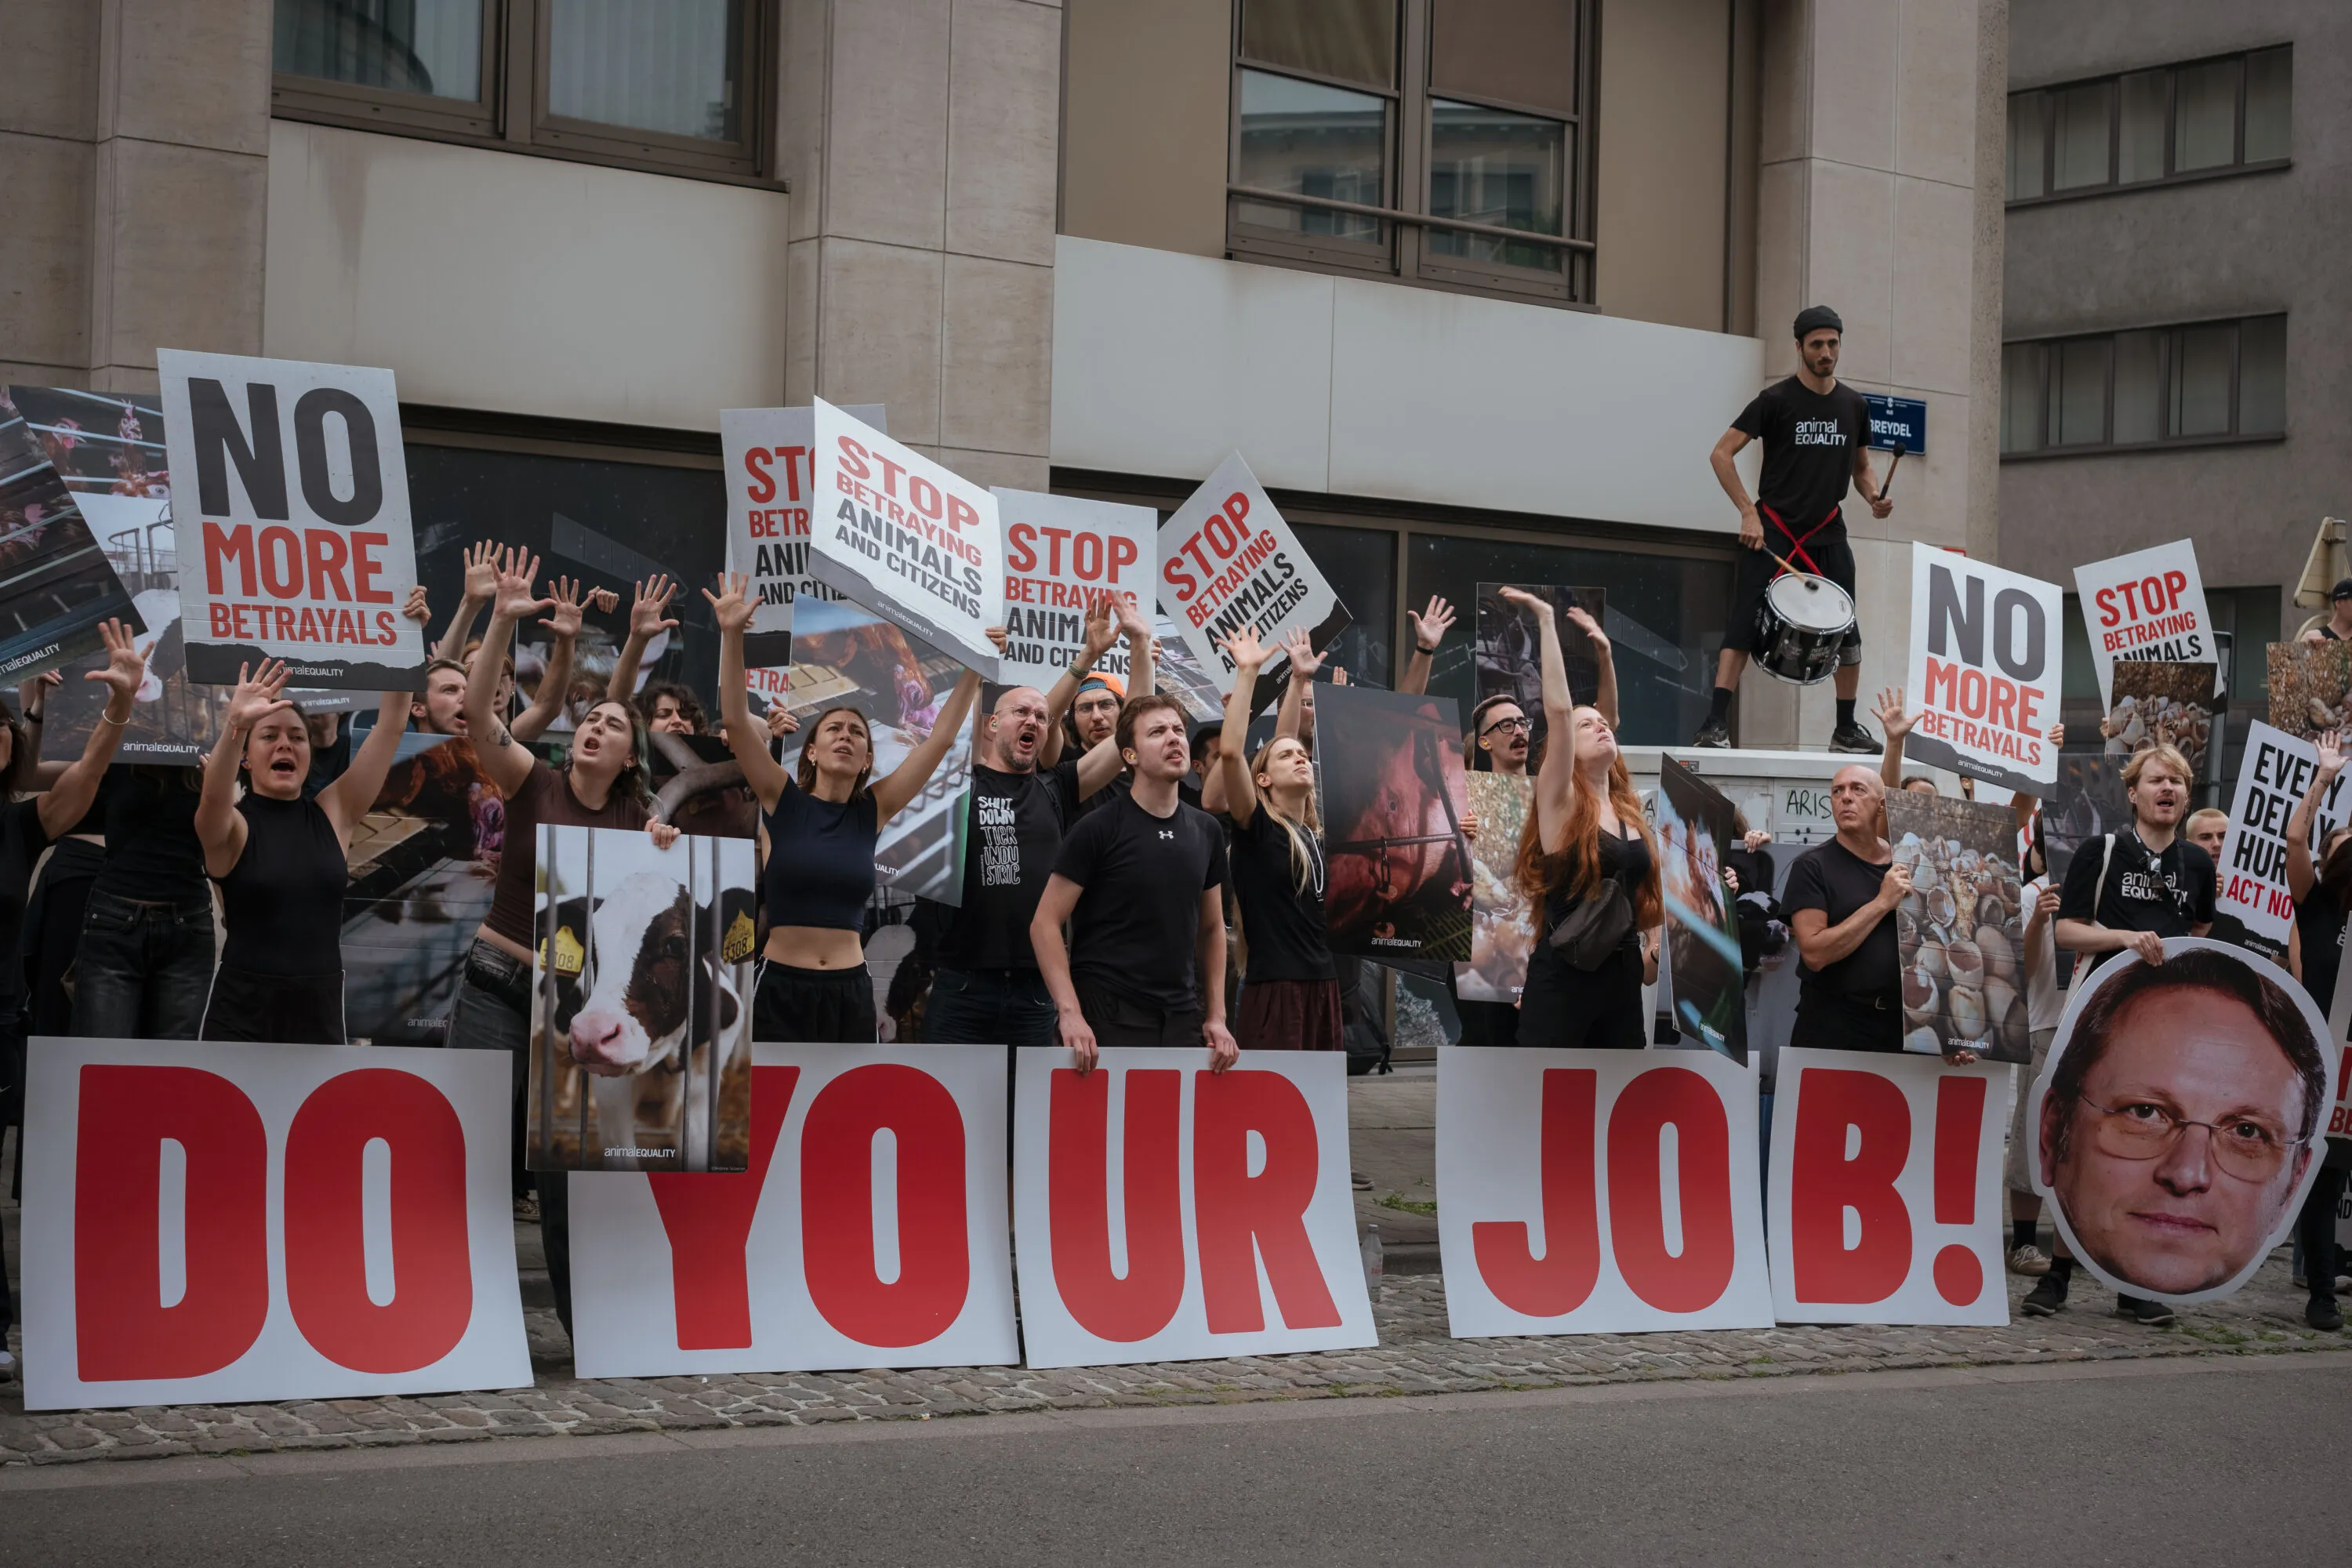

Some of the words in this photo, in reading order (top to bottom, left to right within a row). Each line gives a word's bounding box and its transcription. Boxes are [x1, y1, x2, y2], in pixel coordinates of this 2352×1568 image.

[1795, 416, 1838, 434] animal
[1795, 433, 1847, 446] EQUALITY
[1870, 419, 1911, 437] BREYDEL
[188, 377, 383, 526] NO
[744, 445, 815, 504] ST
[837, 435, 980, 534] STOP
[836, 470, 982, 568] BETRAYING
[202, 522, 394, 604] MORE
[836, 498, 982, 596] ANIMALS
[1007, 523, 1138, 584] STOP
[1163, 492, 1250, 602] STOP
[757, 582, 795, 605] AND
[835, 524, 880, 561] AND
[886, 552, 982, 619] CITIZENS
[1185, 529, 1277, 629] BETRAYING
[877, 601, 934, 637] animalEQUALITY
[1204, 552, 1295, 655] ANIMALS
[2096, 570, 2187, 627] STOP
[209, 602, 397, 646] BETRAYALS
[1927, 563, 2045, 682] NO
[2103, 611, 2197, 652] BETRAYING
[0, 643, 60, 675] malEQUALITY
[278, 663, 344, 677] nimalEQUALITY
[1004, 641, 1044, 665] AND
[1050, 646, 1131, 675] CITENS
[1924, 656, 2045, 739] MORE
[123, 742, 200, 753] animalEQUALITY
[1923, 709, 2042, 766] BETRAYALS
[1958, 759, 2003, 779] animalEQUALITY
[978, 808, 1015, 826] DOWN
[2122, 870, 2177, 888] anial
[2233, 829, 2287, 887] HUR
[2226, 874, 2265, 909] ACT
[2267, 889, 2294, 920] NO
[1370, 935, 1422, 948] animalEQUALITY
[2244, 938, 2280, 957] animalEQUALITY
[1947, 1036, 1990, 1049] animalEQUALITY
[604, 1145, 677, 1158] animalEQUALITY
[74, 1064, 473, 1382] DO
